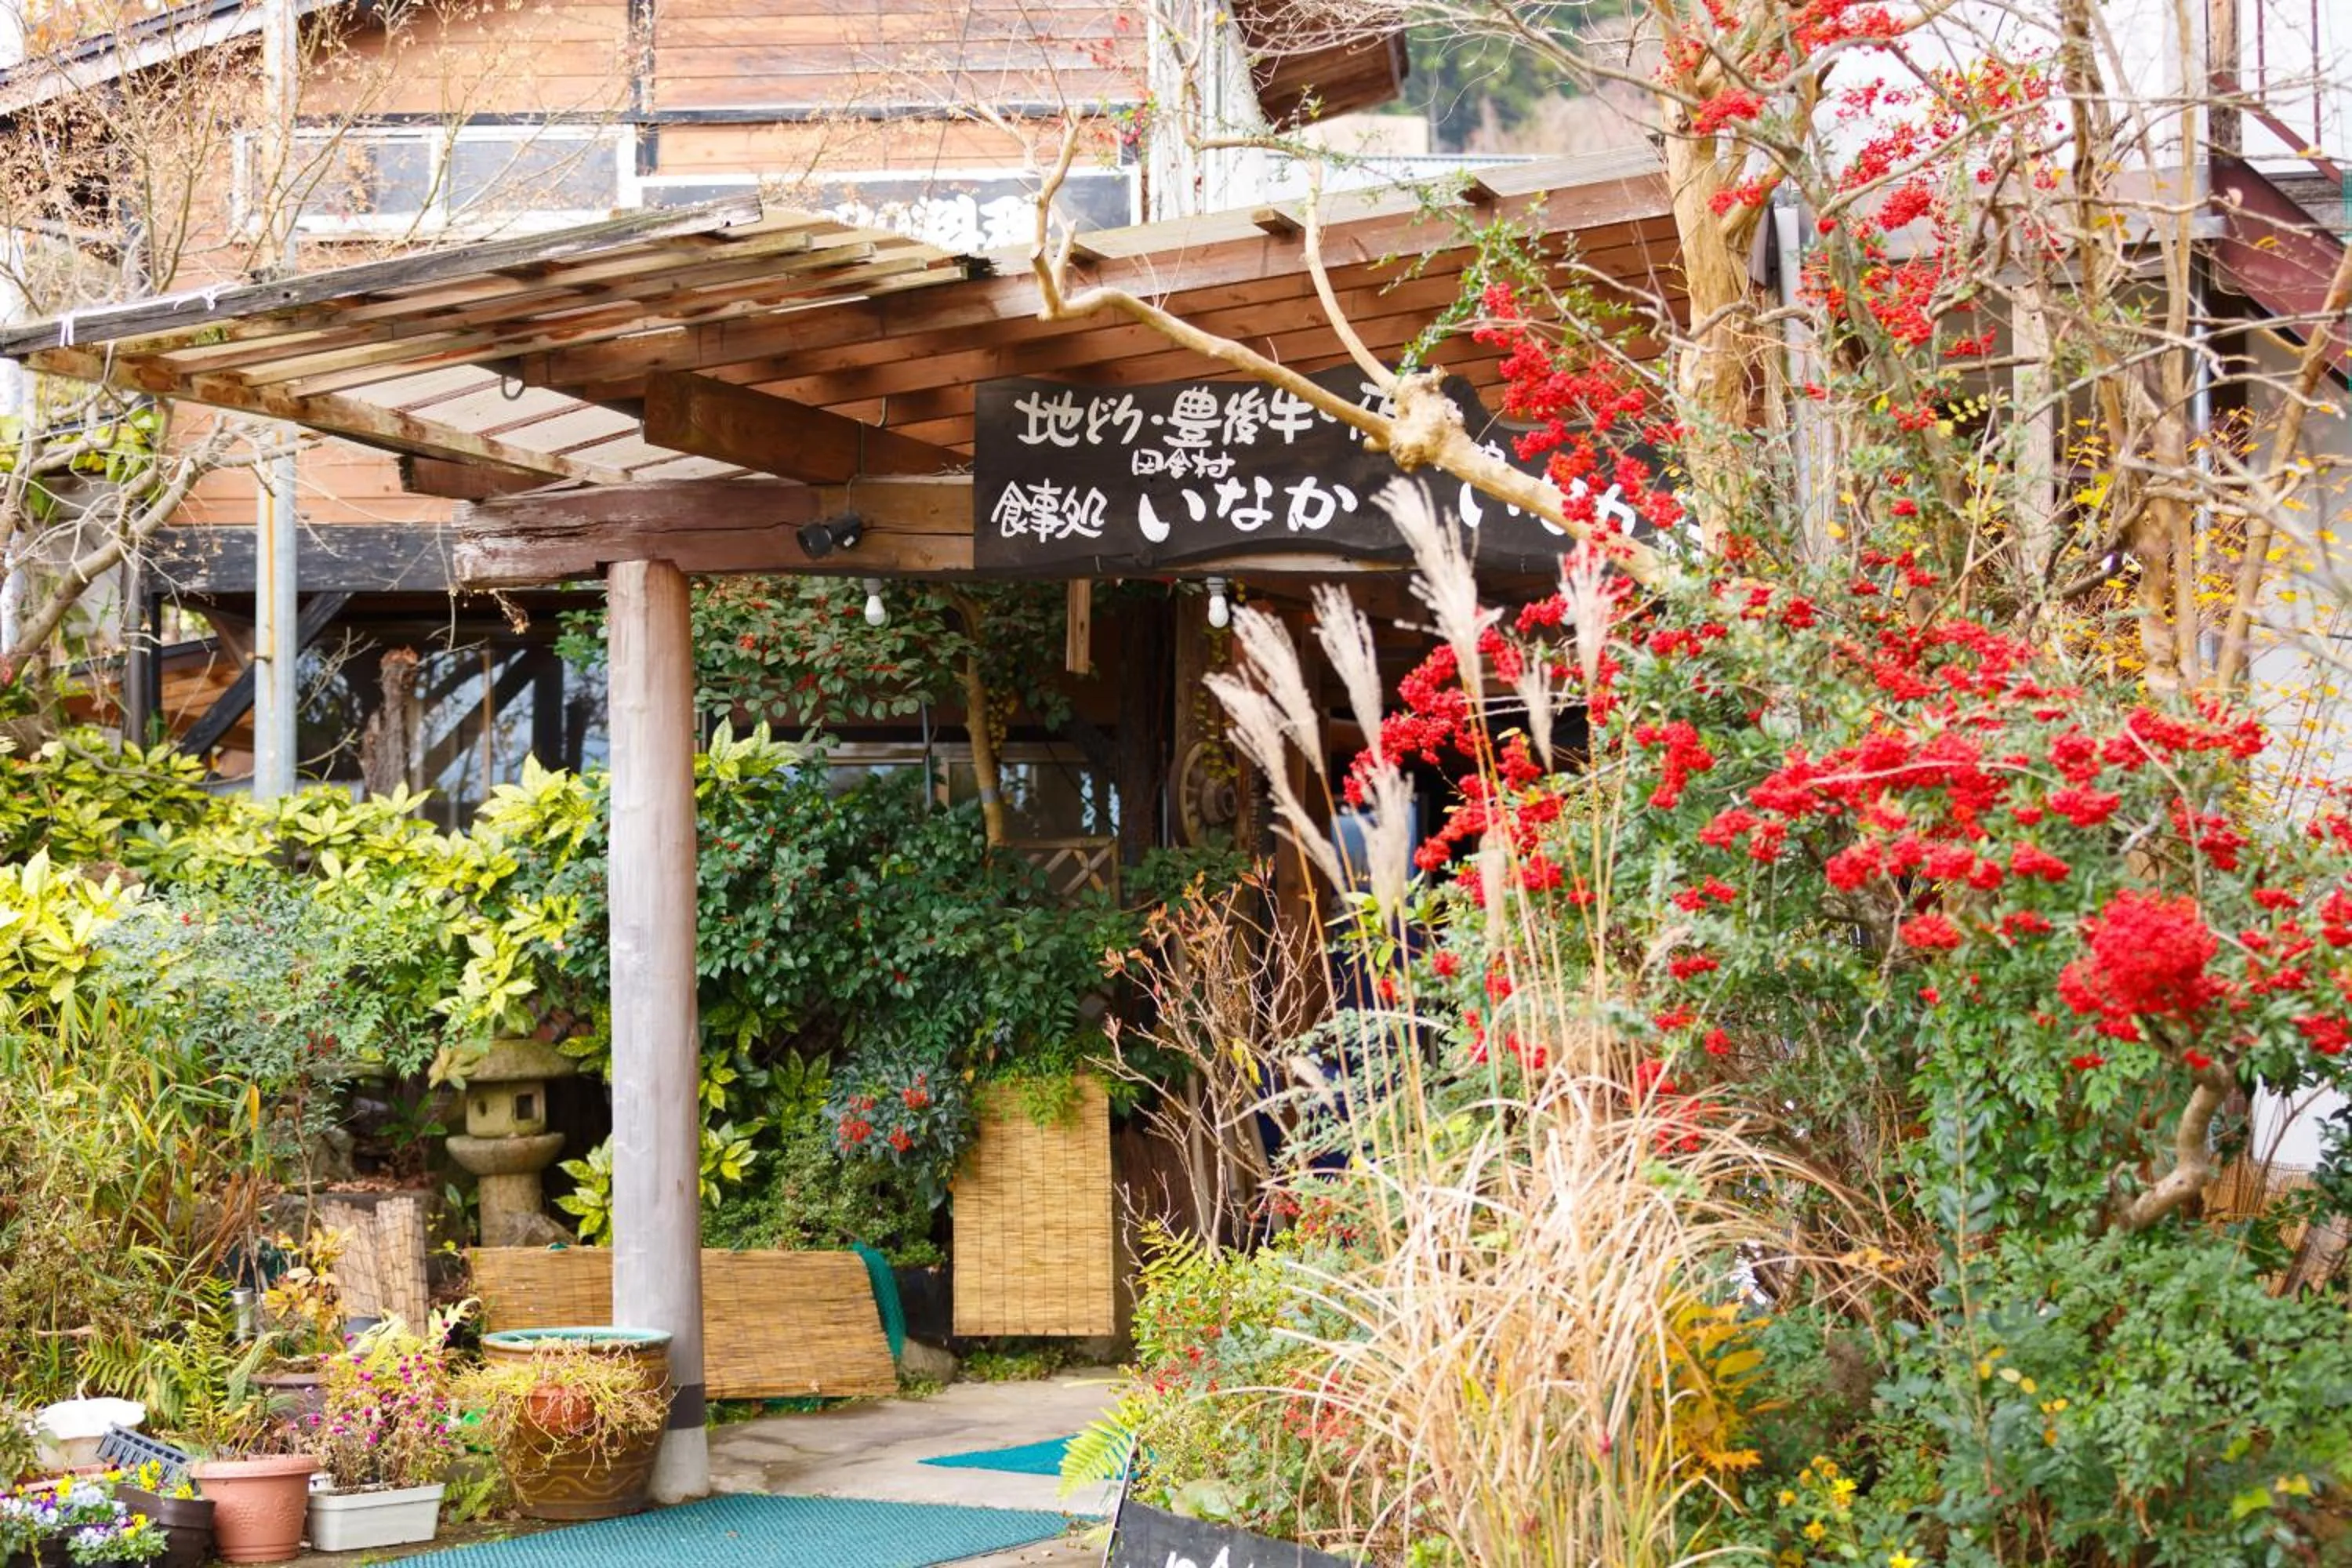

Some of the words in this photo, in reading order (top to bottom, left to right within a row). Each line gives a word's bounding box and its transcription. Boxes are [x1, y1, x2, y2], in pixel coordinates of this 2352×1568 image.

[990, 477, 1108, 543] 食事処
[1138, 475, 1359, 543] いなか
